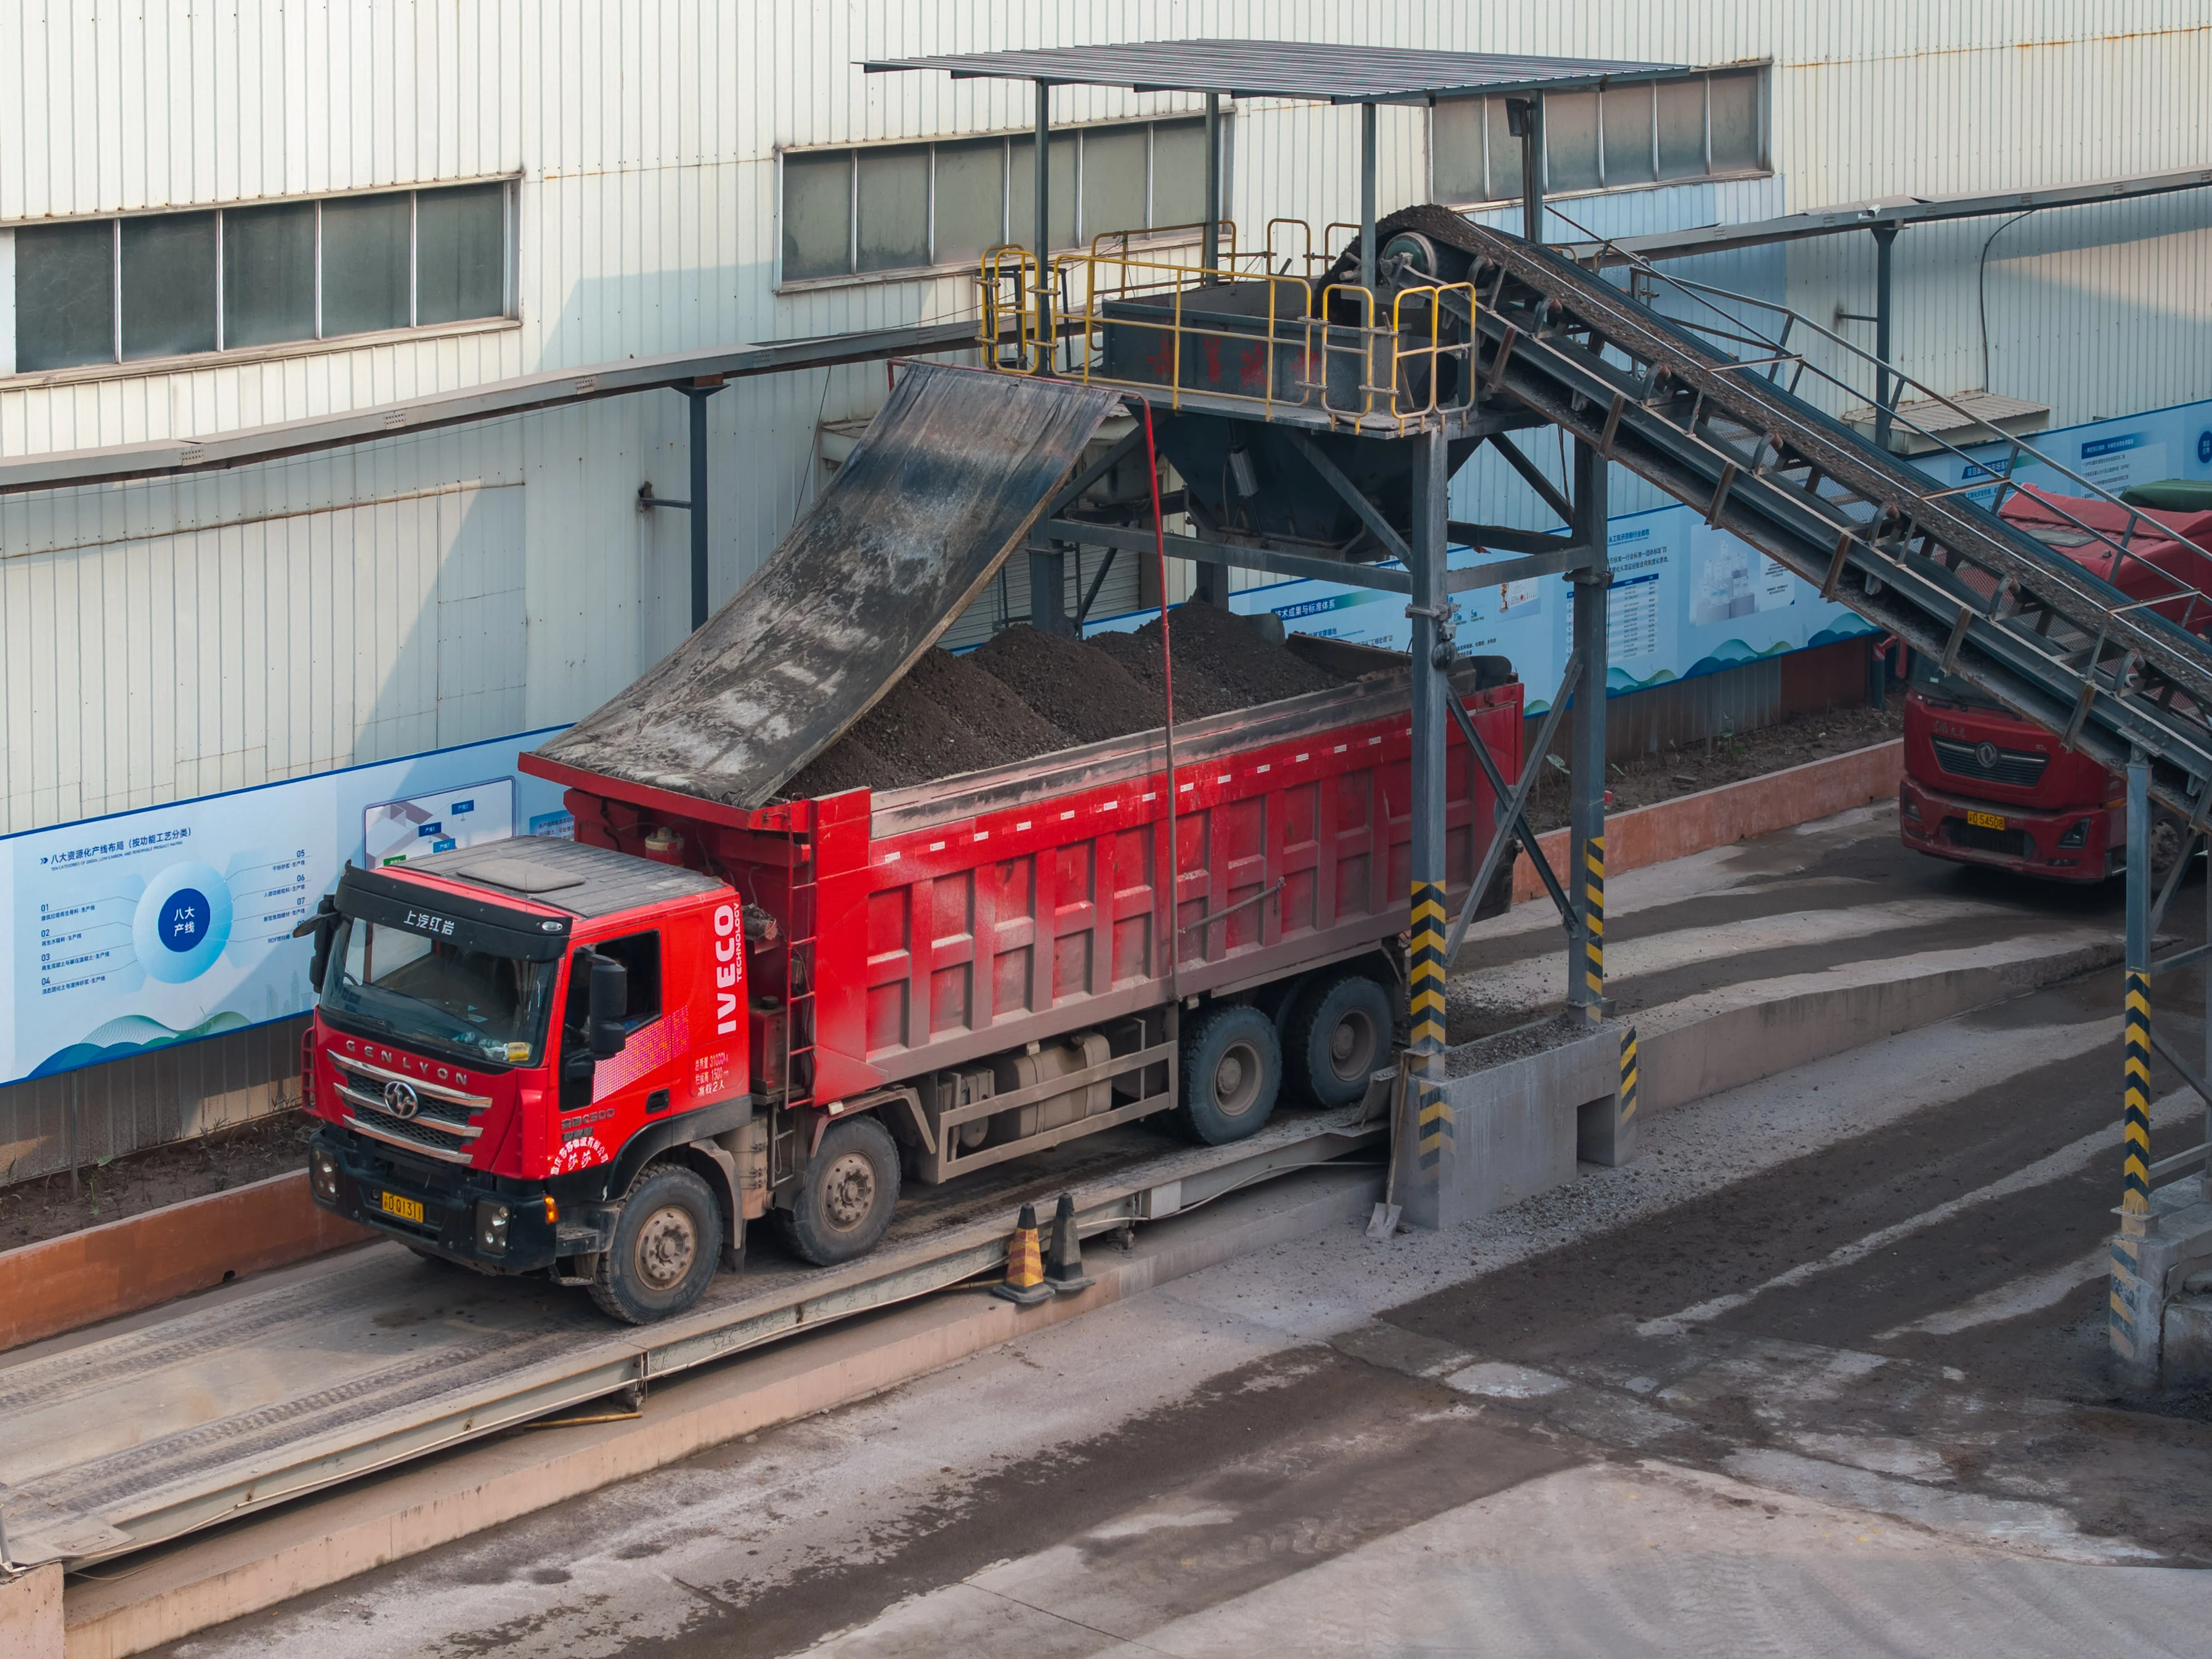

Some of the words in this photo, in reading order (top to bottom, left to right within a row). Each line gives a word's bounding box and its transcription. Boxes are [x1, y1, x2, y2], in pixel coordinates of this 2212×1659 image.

[296, 850, 305, 858] 05
[297, 874, 305, 882] 06
[297, 897, 305, 905] 07
[41, 903, 49, 912] 01
[174, 906, 195, 921] 八大
[403, 910, 455, 935] 上汽红岩
[41, 929, 50, 937] 02
[174, 921, 195, 936] 产线
[733, 903, 742, 983] TECHNOLOGY
[41, 953, 50, 962] 03
[714, 904, 737, 1035] IVECO
[41, 976, 51, 986] 04
